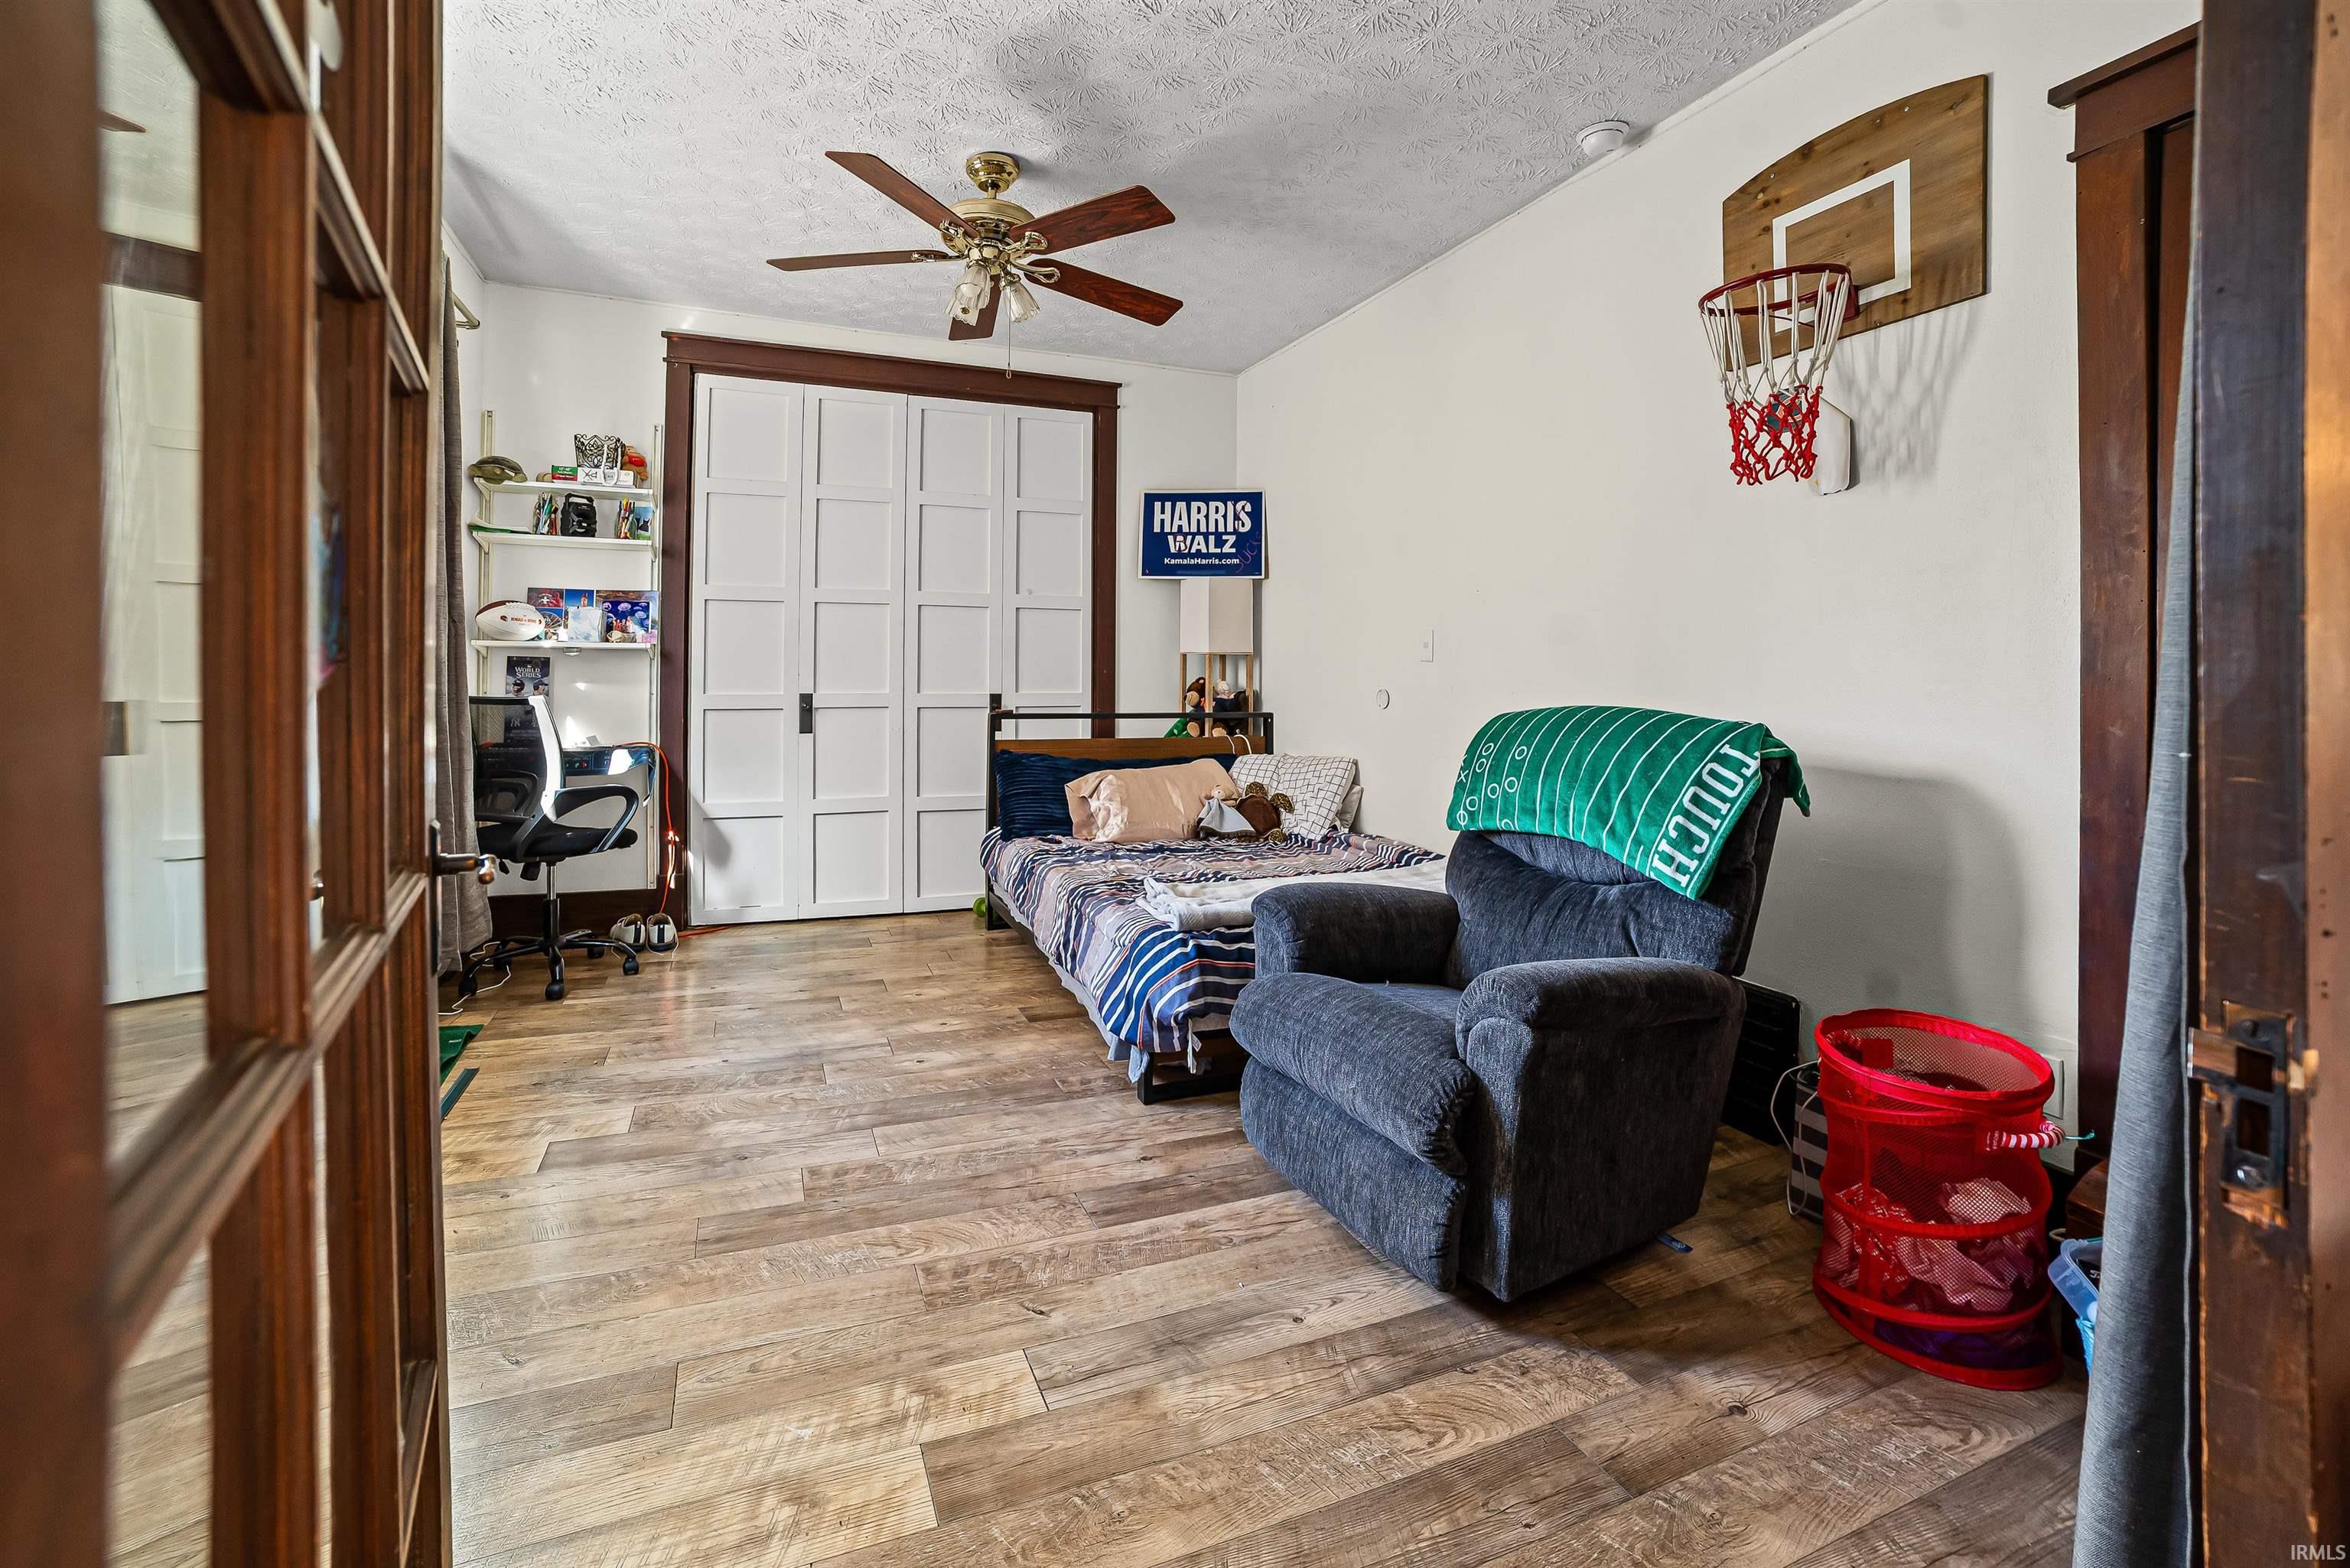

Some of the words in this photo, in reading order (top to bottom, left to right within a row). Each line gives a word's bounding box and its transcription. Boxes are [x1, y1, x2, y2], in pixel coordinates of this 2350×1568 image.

[1154, 500, 1252, 532] HARRIS
[1167, 535, 1236, 553] WALZ
[1164, 557, 1239, 565] KamalaHarris.com
[1651, 743, 1760, 888] TOUCH
